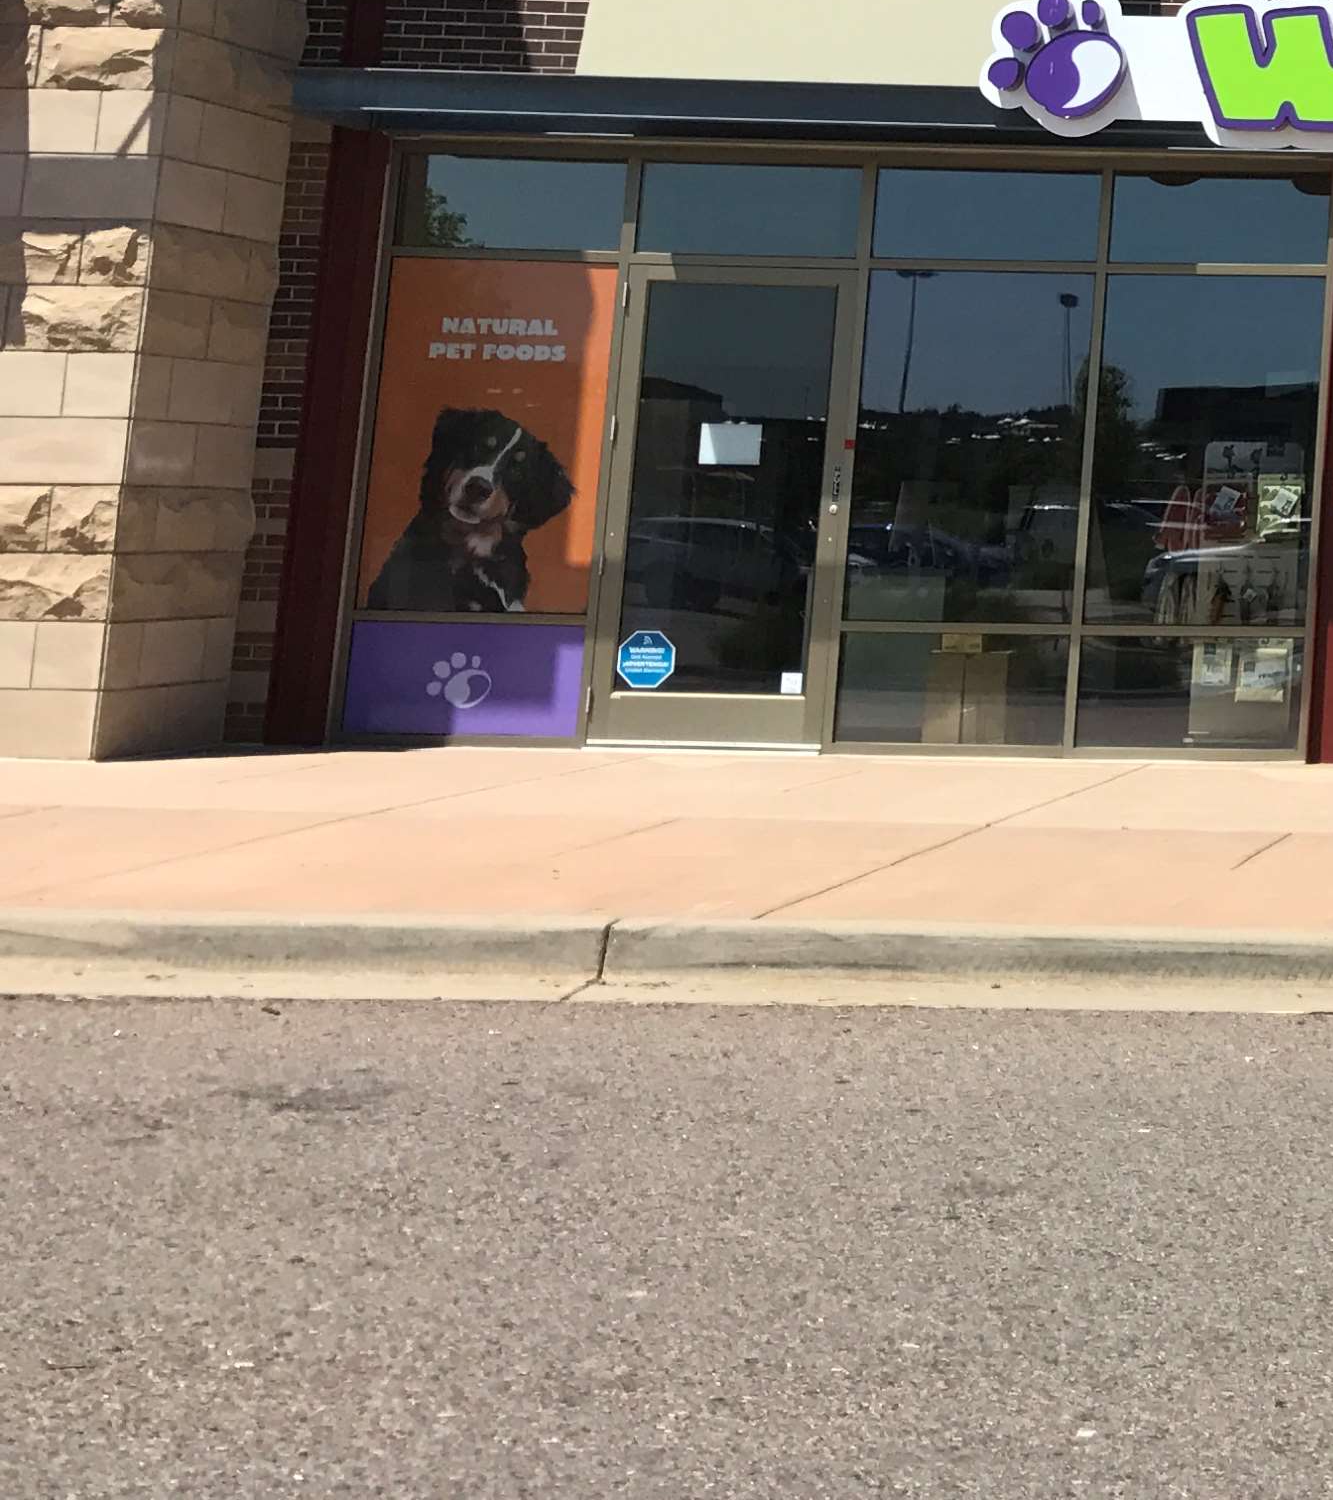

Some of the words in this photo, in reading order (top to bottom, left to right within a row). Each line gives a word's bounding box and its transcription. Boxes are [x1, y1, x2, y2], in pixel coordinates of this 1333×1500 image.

[441, 316, 559, 336] NATURAL
[428, 342, 476, 360] PET
[482, 344, 567, 362] FOODS
